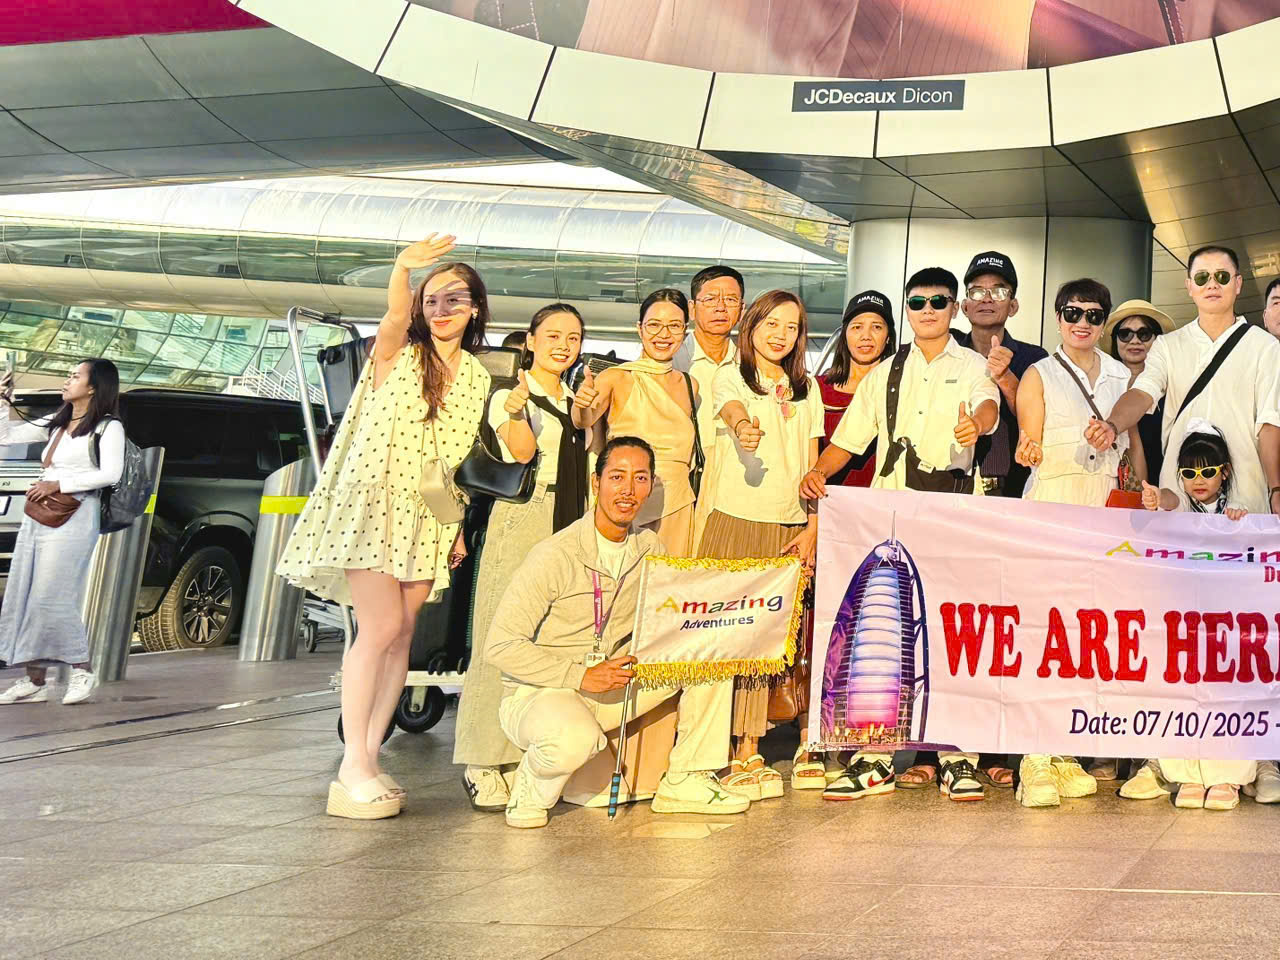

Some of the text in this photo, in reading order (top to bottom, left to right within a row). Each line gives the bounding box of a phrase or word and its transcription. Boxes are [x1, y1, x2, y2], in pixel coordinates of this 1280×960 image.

[804, 87, 953, 105] JCDecaux Dicon
[655, 594, 784, 615] Amazing
[680, 615, 755, 631] Adventures
[939, 602, 1022, 678] WE
[1036, 606, 1148, 682] ARE
[1069, 708, 1128, 735] Date:
[1132, 709, 1270, 738] 07/10/2025
